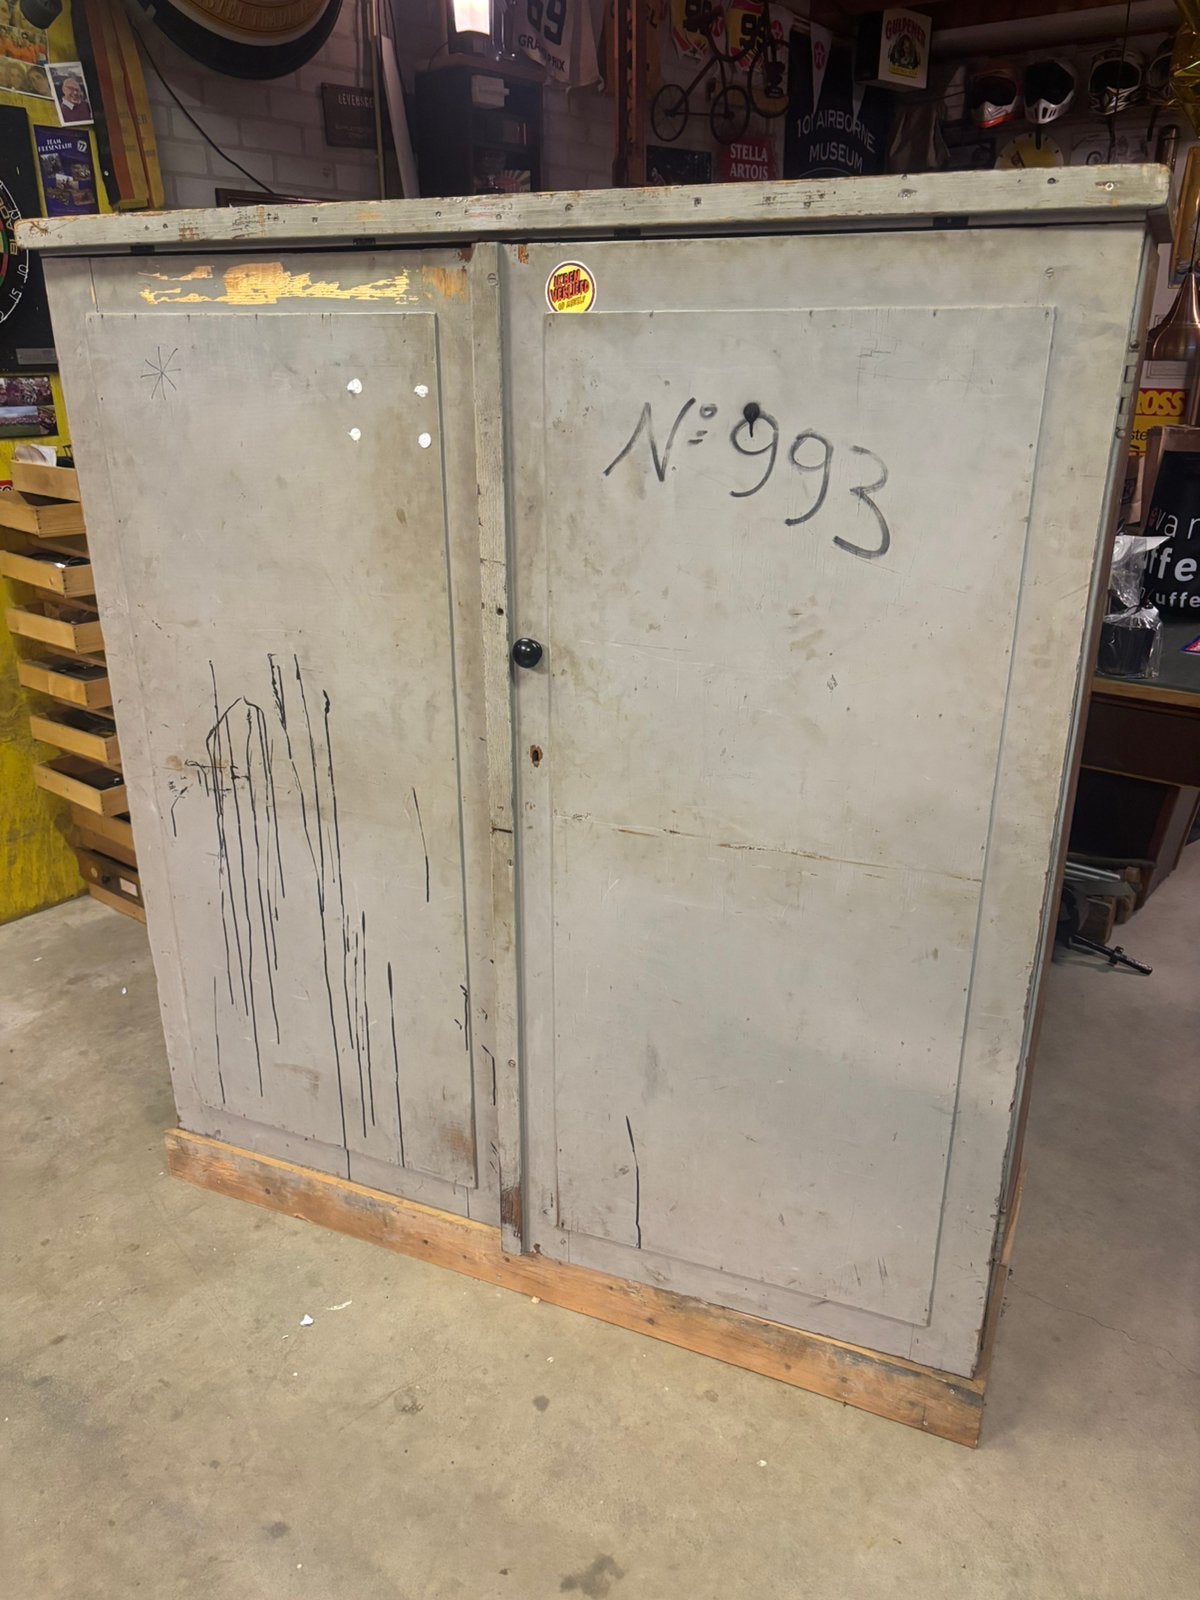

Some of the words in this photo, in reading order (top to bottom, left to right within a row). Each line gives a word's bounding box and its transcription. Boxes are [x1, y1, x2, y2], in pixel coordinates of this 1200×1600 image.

[816, 109, 876, 154] AIRBORNE
[729, 143, 769, 163] STELLA
[808, 141, 863, 174] MUSEUM
[729, 163, 769, 181] ARTOIS
